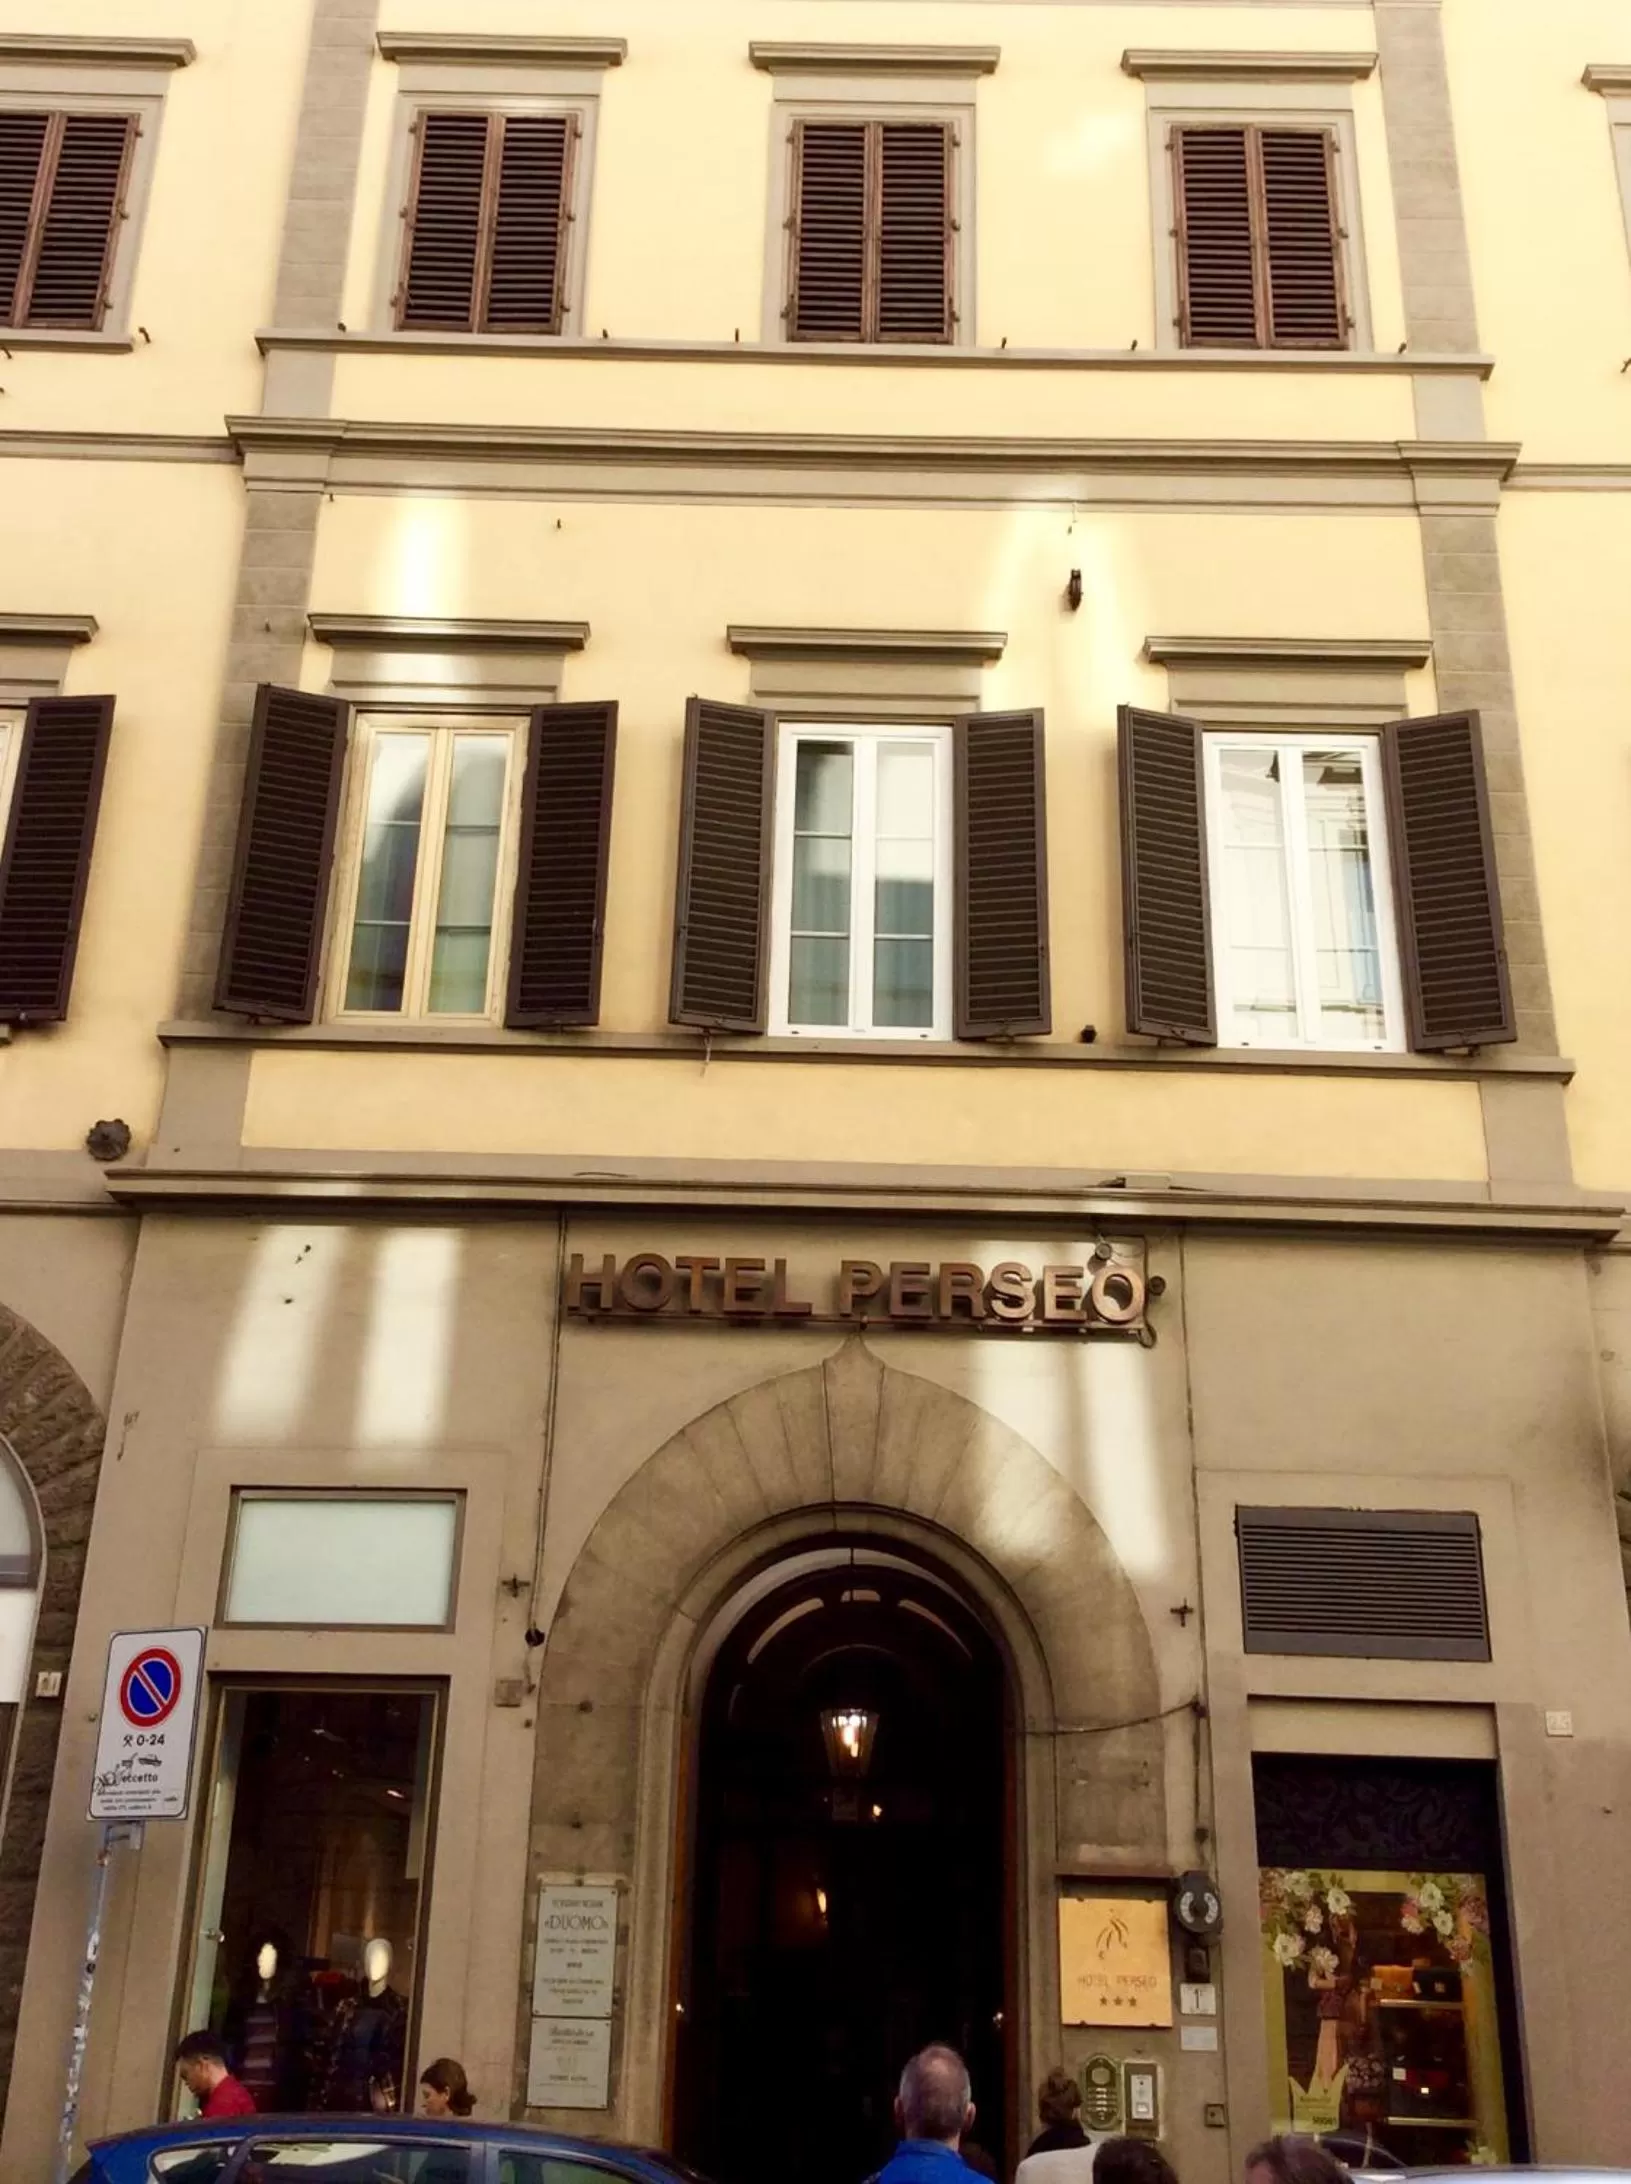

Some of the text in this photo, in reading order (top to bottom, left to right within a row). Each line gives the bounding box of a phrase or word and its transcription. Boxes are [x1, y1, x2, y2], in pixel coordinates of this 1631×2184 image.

[565, 1253, 1145, 1324] HOTEL PERSEO
[136, 1734, 166, 1747] 0-24
[120, 1773, 159, 1784] eccetto
